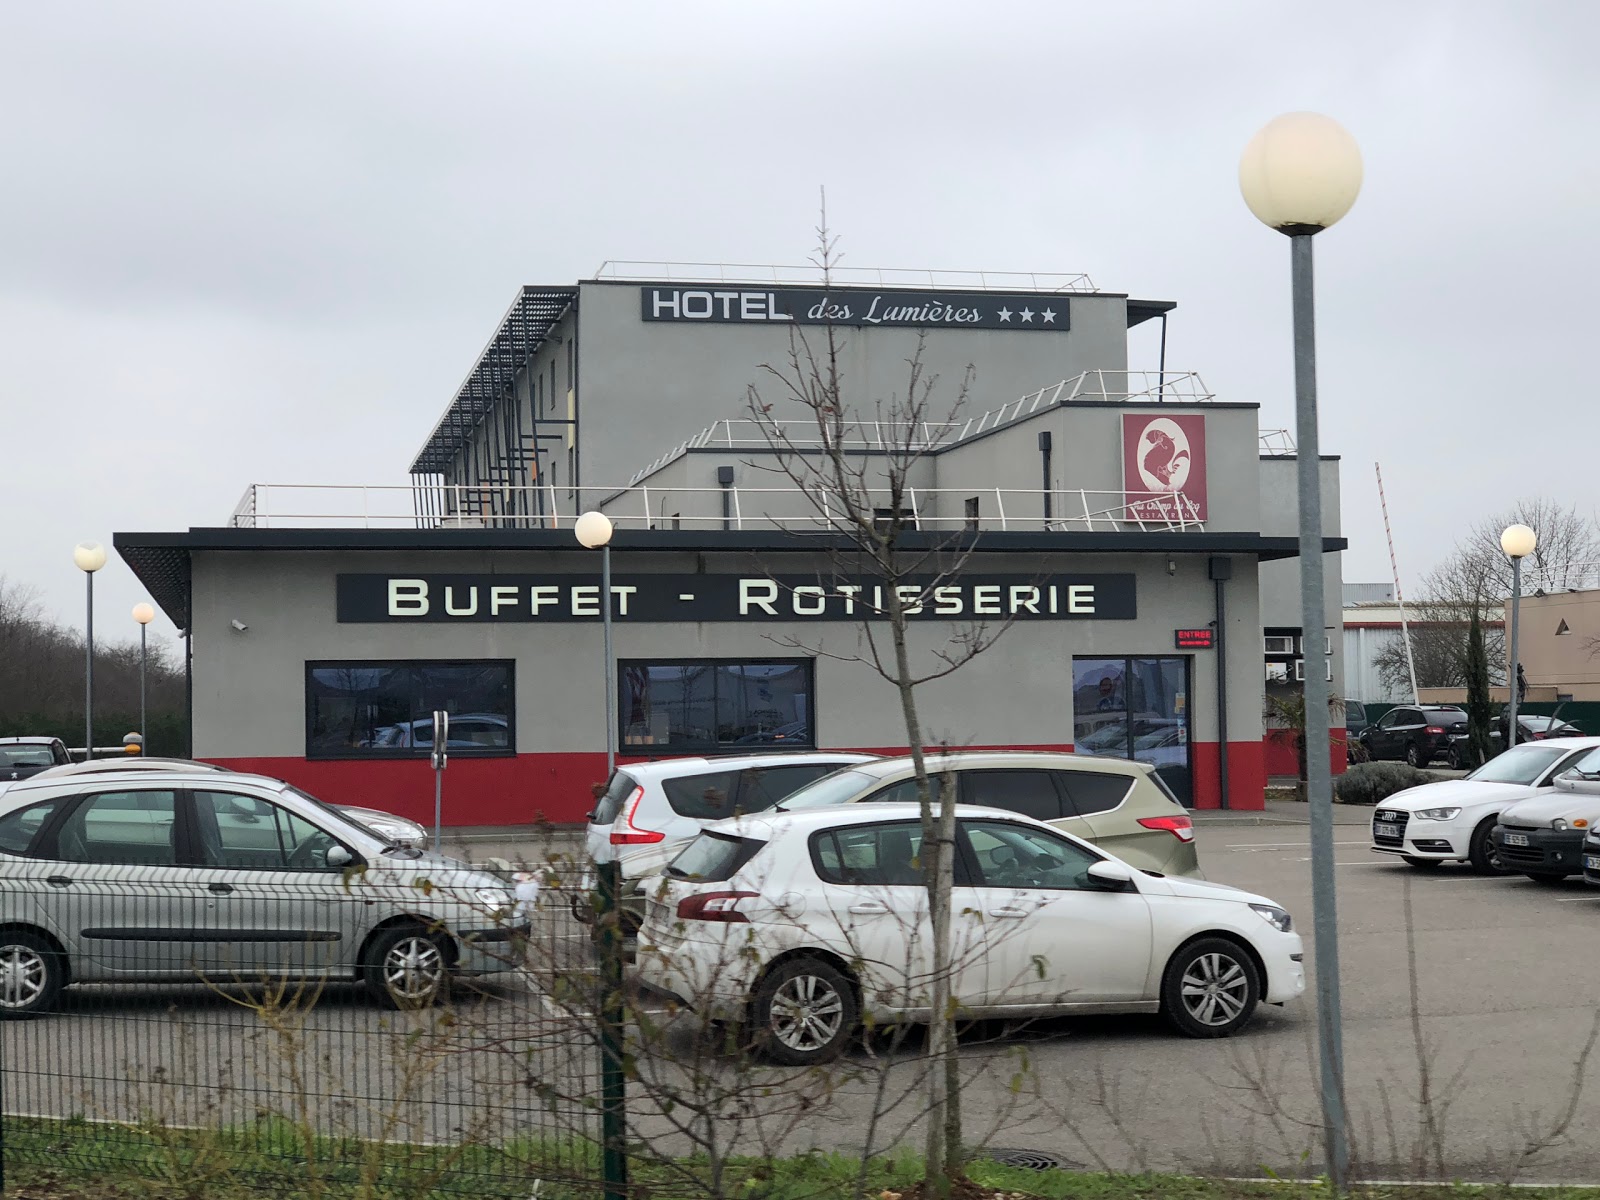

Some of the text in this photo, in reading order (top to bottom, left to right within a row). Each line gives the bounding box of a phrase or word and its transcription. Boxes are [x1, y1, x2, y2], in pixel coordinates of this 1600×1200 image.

[652, 290, 982, 324] HOTEL des Lumières
[388, 578, 637, 617] BUFFET
[738, 578, 1096, 616] ROTISSERIE
